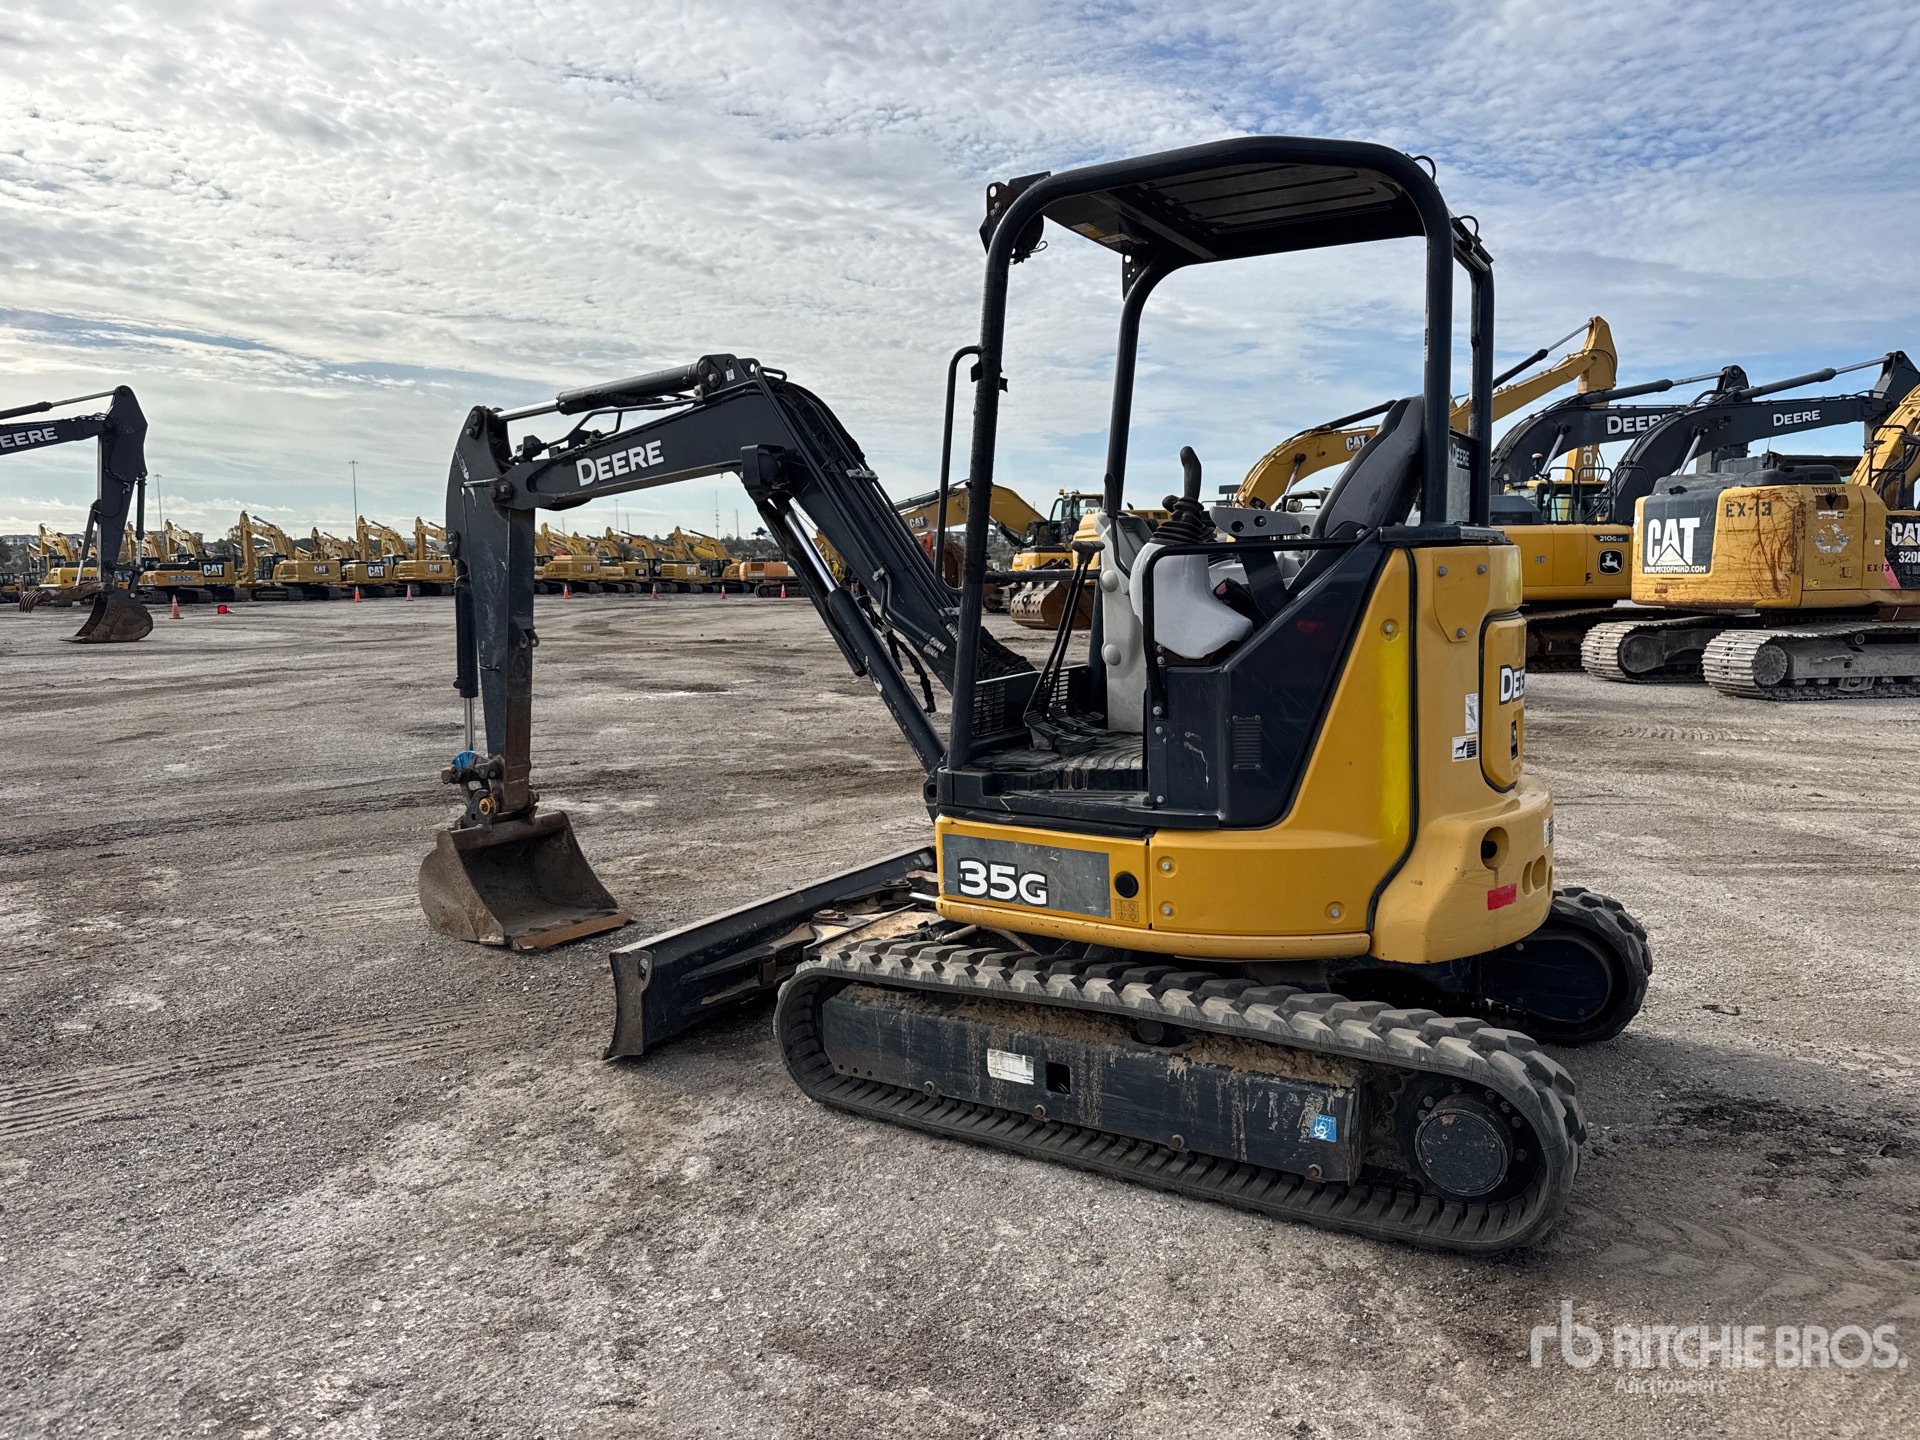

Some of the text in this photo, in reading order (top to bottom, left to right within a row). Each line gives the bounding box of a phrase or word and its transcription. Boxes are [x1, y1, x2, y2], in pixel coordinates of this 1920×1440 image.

[1606, 414, 1668, 435] DEER
[1773, 410, 1821, 427] DEERE
[1346, 435, 1367, 451] CAT
[1452, 443, 1470, 467] DEERE
[576, 440, 664, 487] DEERE
[1726, 502, 1772, 518] EX-13
[909, 516, 925, 528] CAT
[1646, 517, 1700, 566] CAT
[203, 564, 223, 576] CAT
[313, 565, 326, 574] CAT
[367, 565, 384, 577] CAT
[429, 564, 440, 572] CAT
[1867, 564, 1890, 572] EX-13
[959, 860, 1048, 905] 35G
